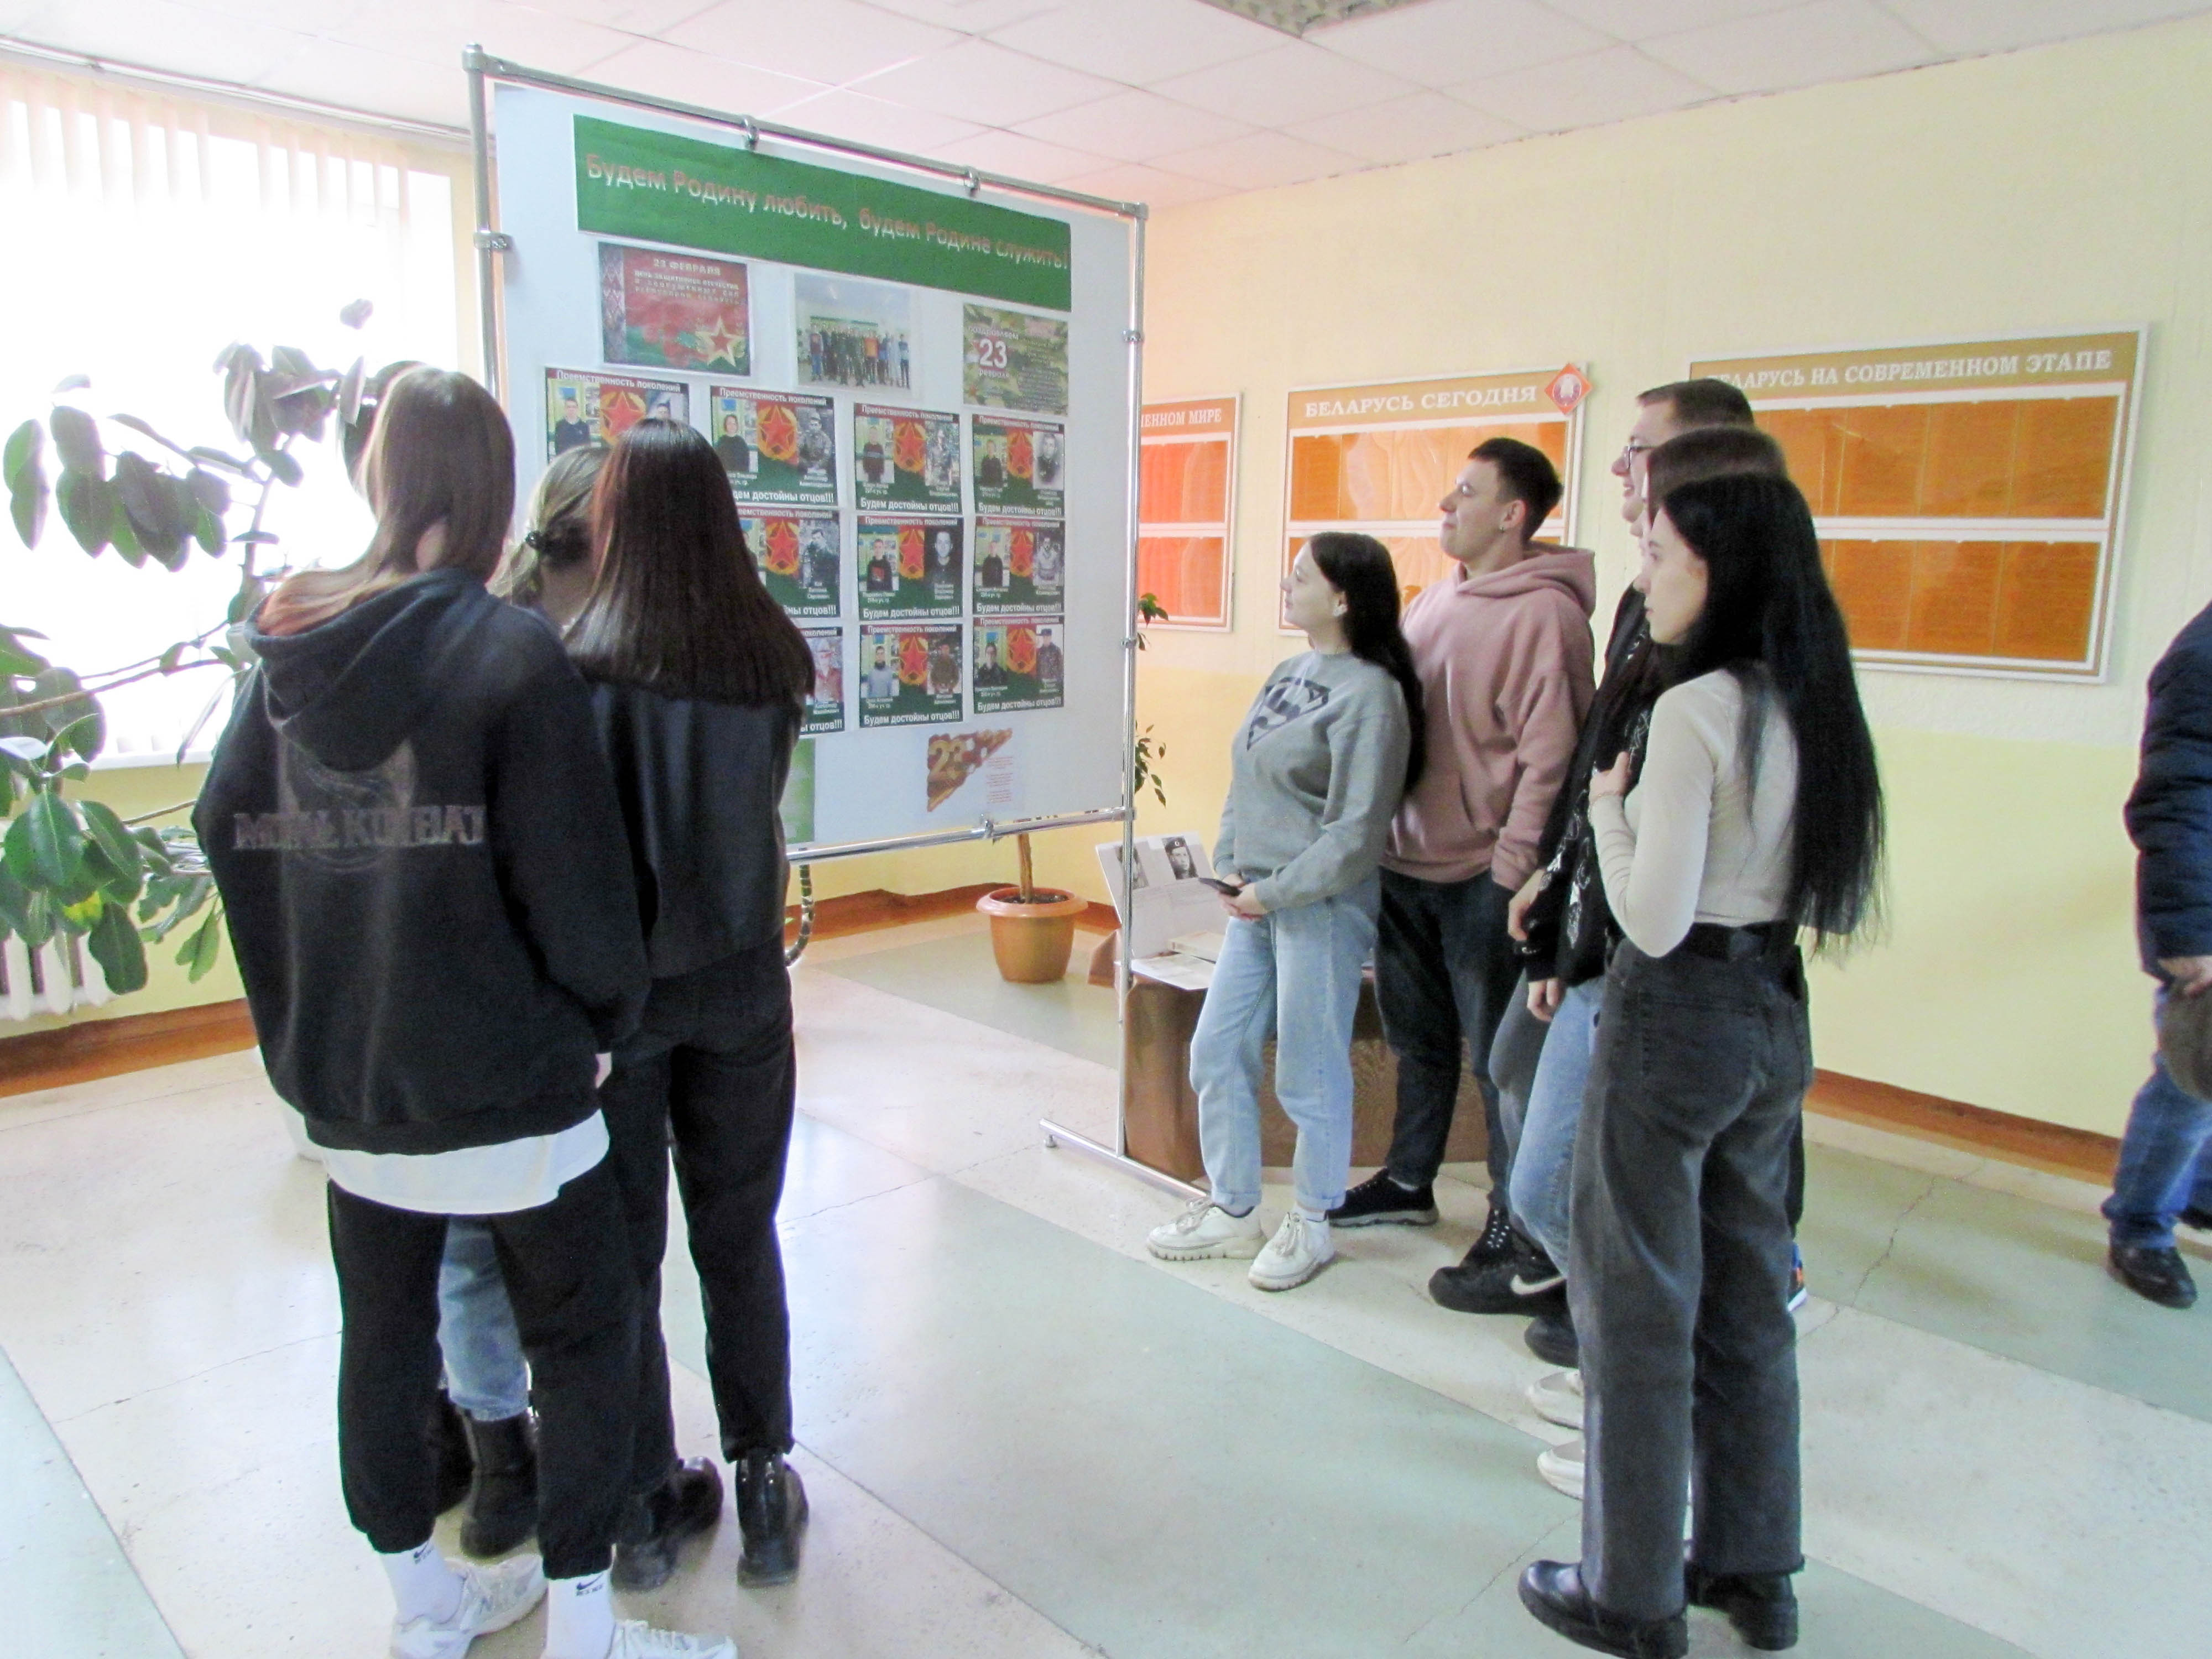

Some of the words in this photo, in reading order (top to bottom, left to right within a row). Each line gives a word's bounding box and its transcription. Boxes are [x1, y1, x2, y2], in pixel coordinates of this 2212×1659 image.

[586, 154, 666, 191] Будем
[673, 170, 757, 212] Родину
[763, 195, 847, 229] любить,
[859, 207, 920, 239] будем
[925, 222, 990, 254] Родине
[996, 241, 1067, 269] служить!
[980, 338, 1007, 368] 23
[1811, 367, 1838, 385] НА
[1845, 355, 2019, 383] СОВРЕМЕННОМ
[2026, 349, 2111, 373] ЭТАПЕ
[556, 370, 635, 387] Преемственность
[637, 380, 681, 392] поколений
[719, 388, 787, 402] Преемственность
[1305, 395, 1414, 418] БЕЛАРУСЬ
[1421, 385, 1537, 409] СЕГОДНЯ
[1188, 408, 1222, 425] МИРЕ
[733, 491, 750, 500] дем
[752, 490, 798, 501] достойны
[800, 492, 834, 503] отцов!!!
[860, 497, 887, 510] Будем
[888, 499, 928, 510] достойны
[979, 502, 1001, 514] Будем
[803, 605, 836, 616] отцов!!!
[863, 608, 889, 619] Будем
[889, 607, 929, 618] достойны
[977, 602, 999, 614] Будем
[1001, 602, 1035, 614] достойны
[977, 702, 1000, 712] Будем
[1001, 699, 1035, 711] достойны
[864, 714, 889, 726] Будем
[891, 712, 930, 724] достойны
[342, 805, 487, 848] KOMBAT
